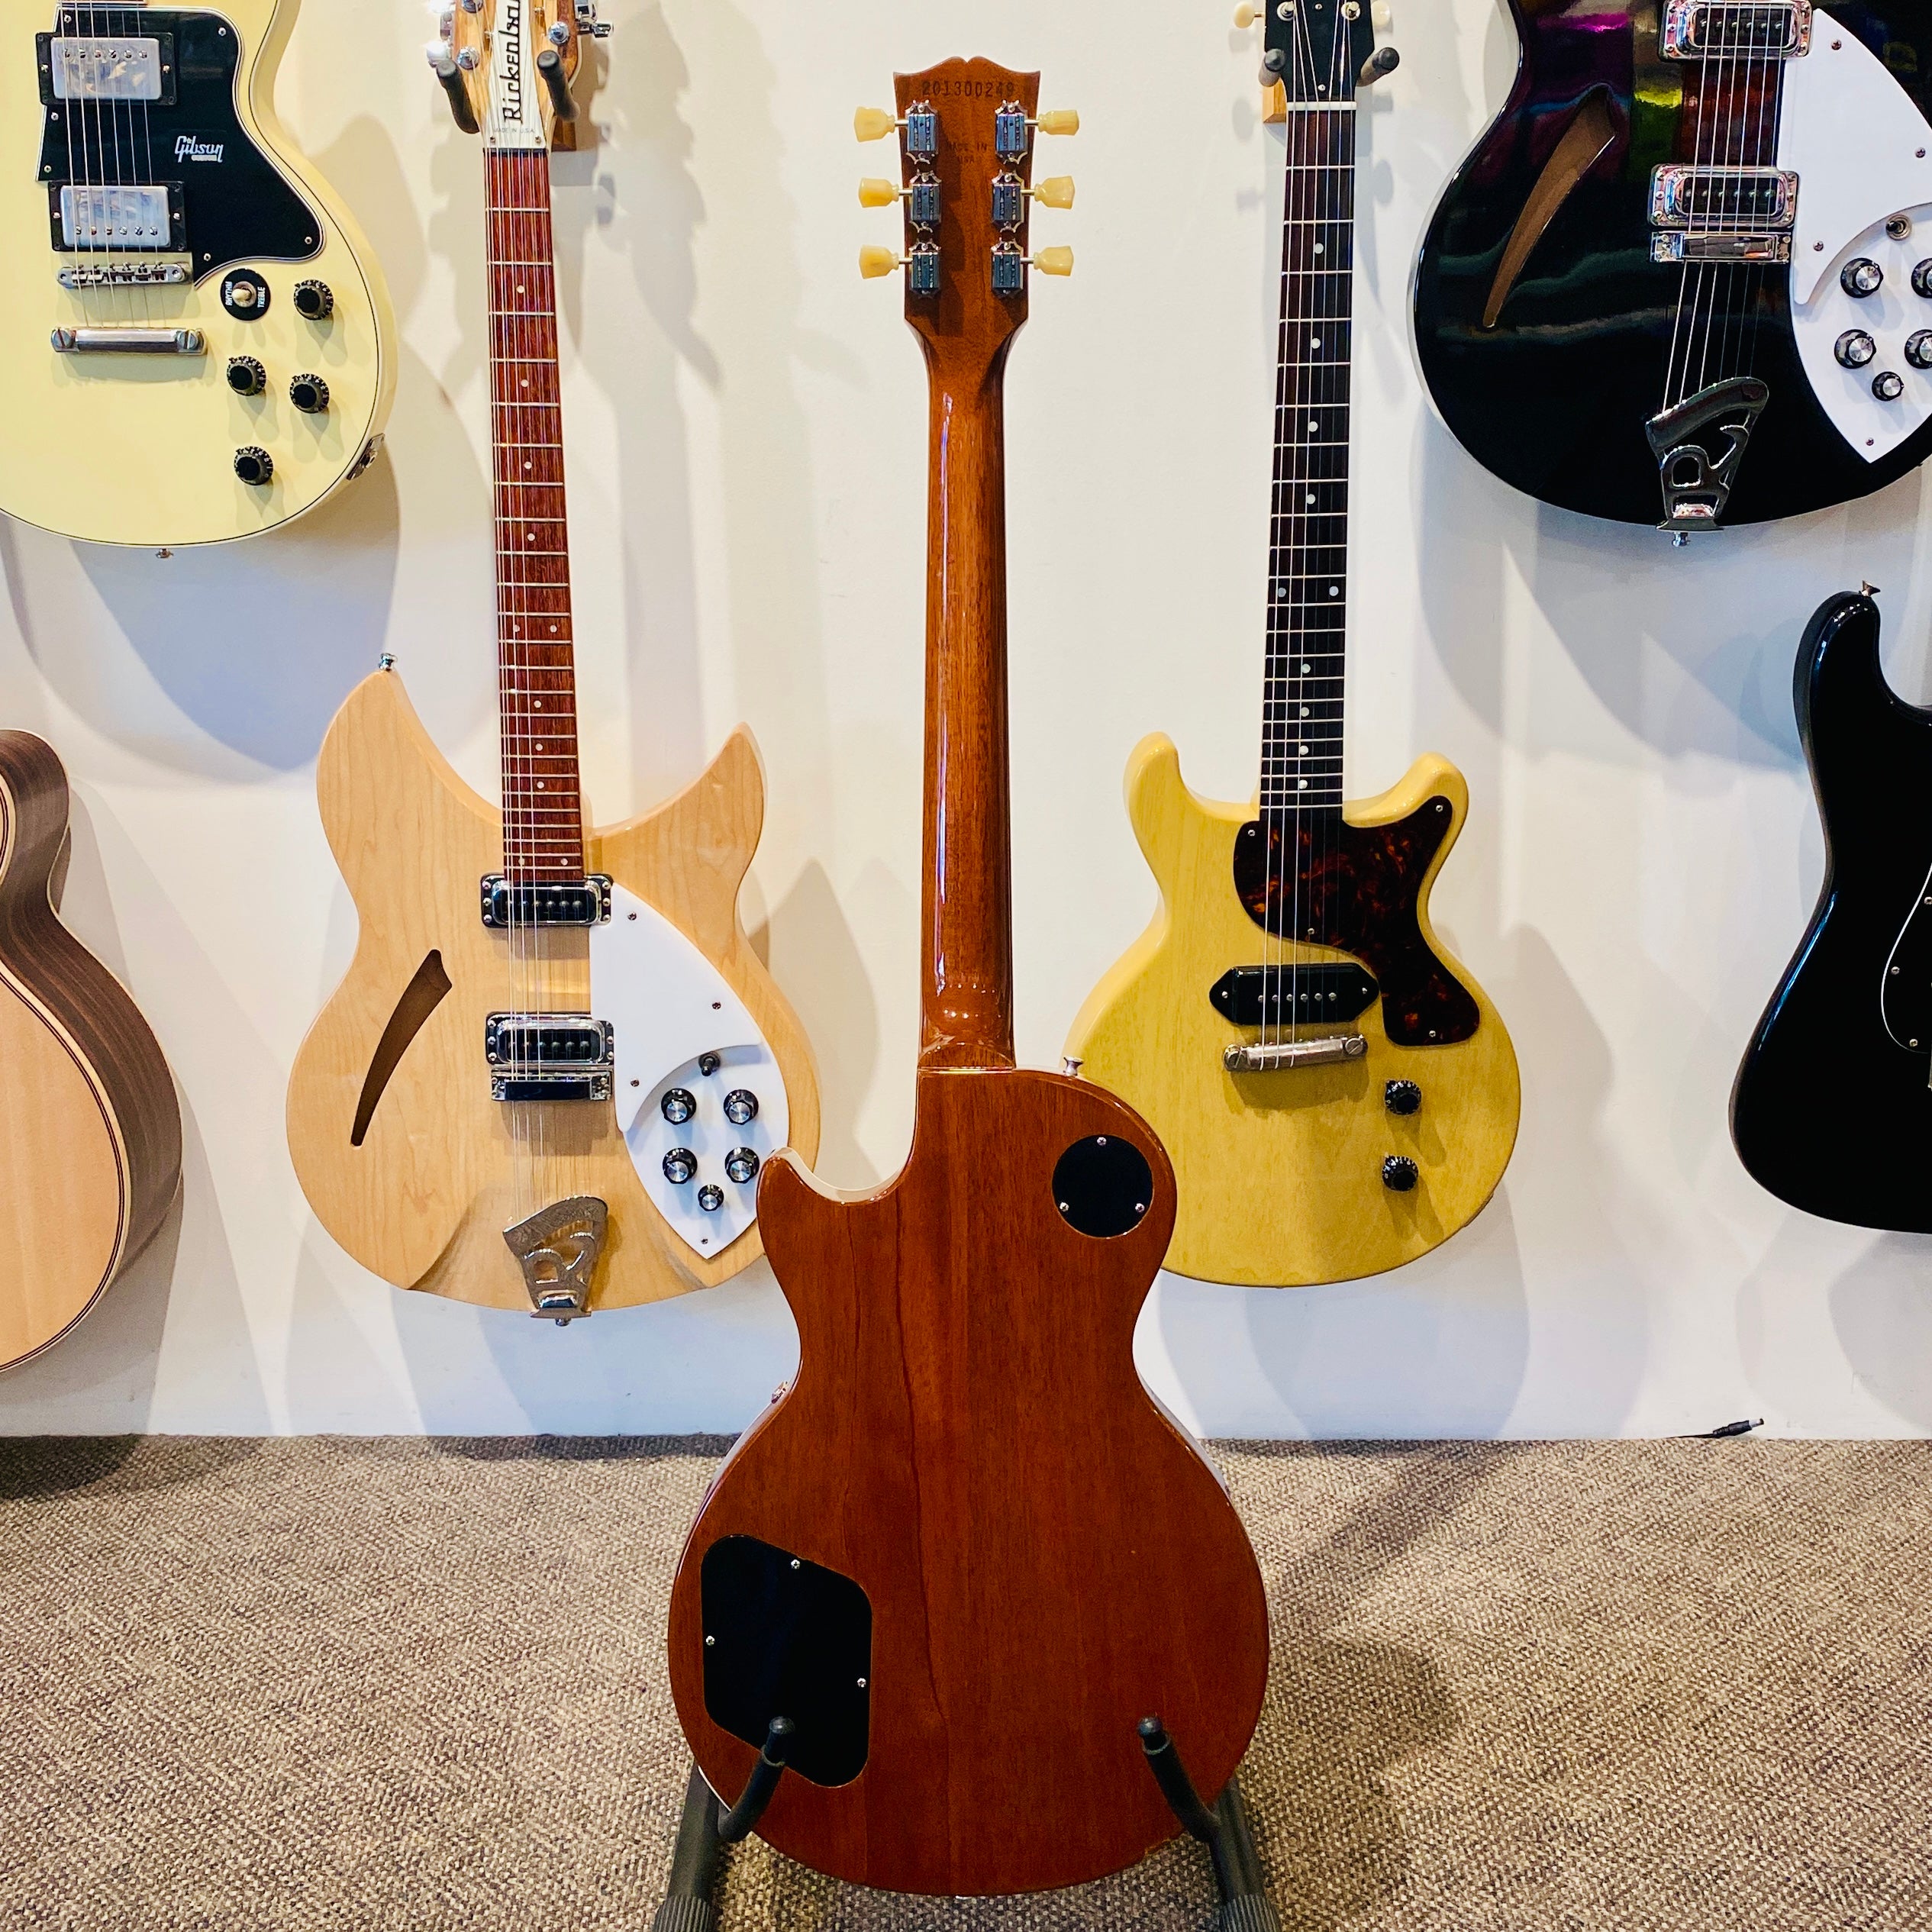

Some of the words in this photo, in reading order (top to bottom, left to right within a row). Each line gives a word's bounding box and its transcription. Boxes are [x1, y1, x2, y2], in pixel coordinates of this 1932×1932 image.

[498, 0, 523, 124] Rickenba
[174, 135, 224, 163] Gibson
[224, 281, 233, 306] RHYTHM
[256, 286, 266, 308] TREBLE
